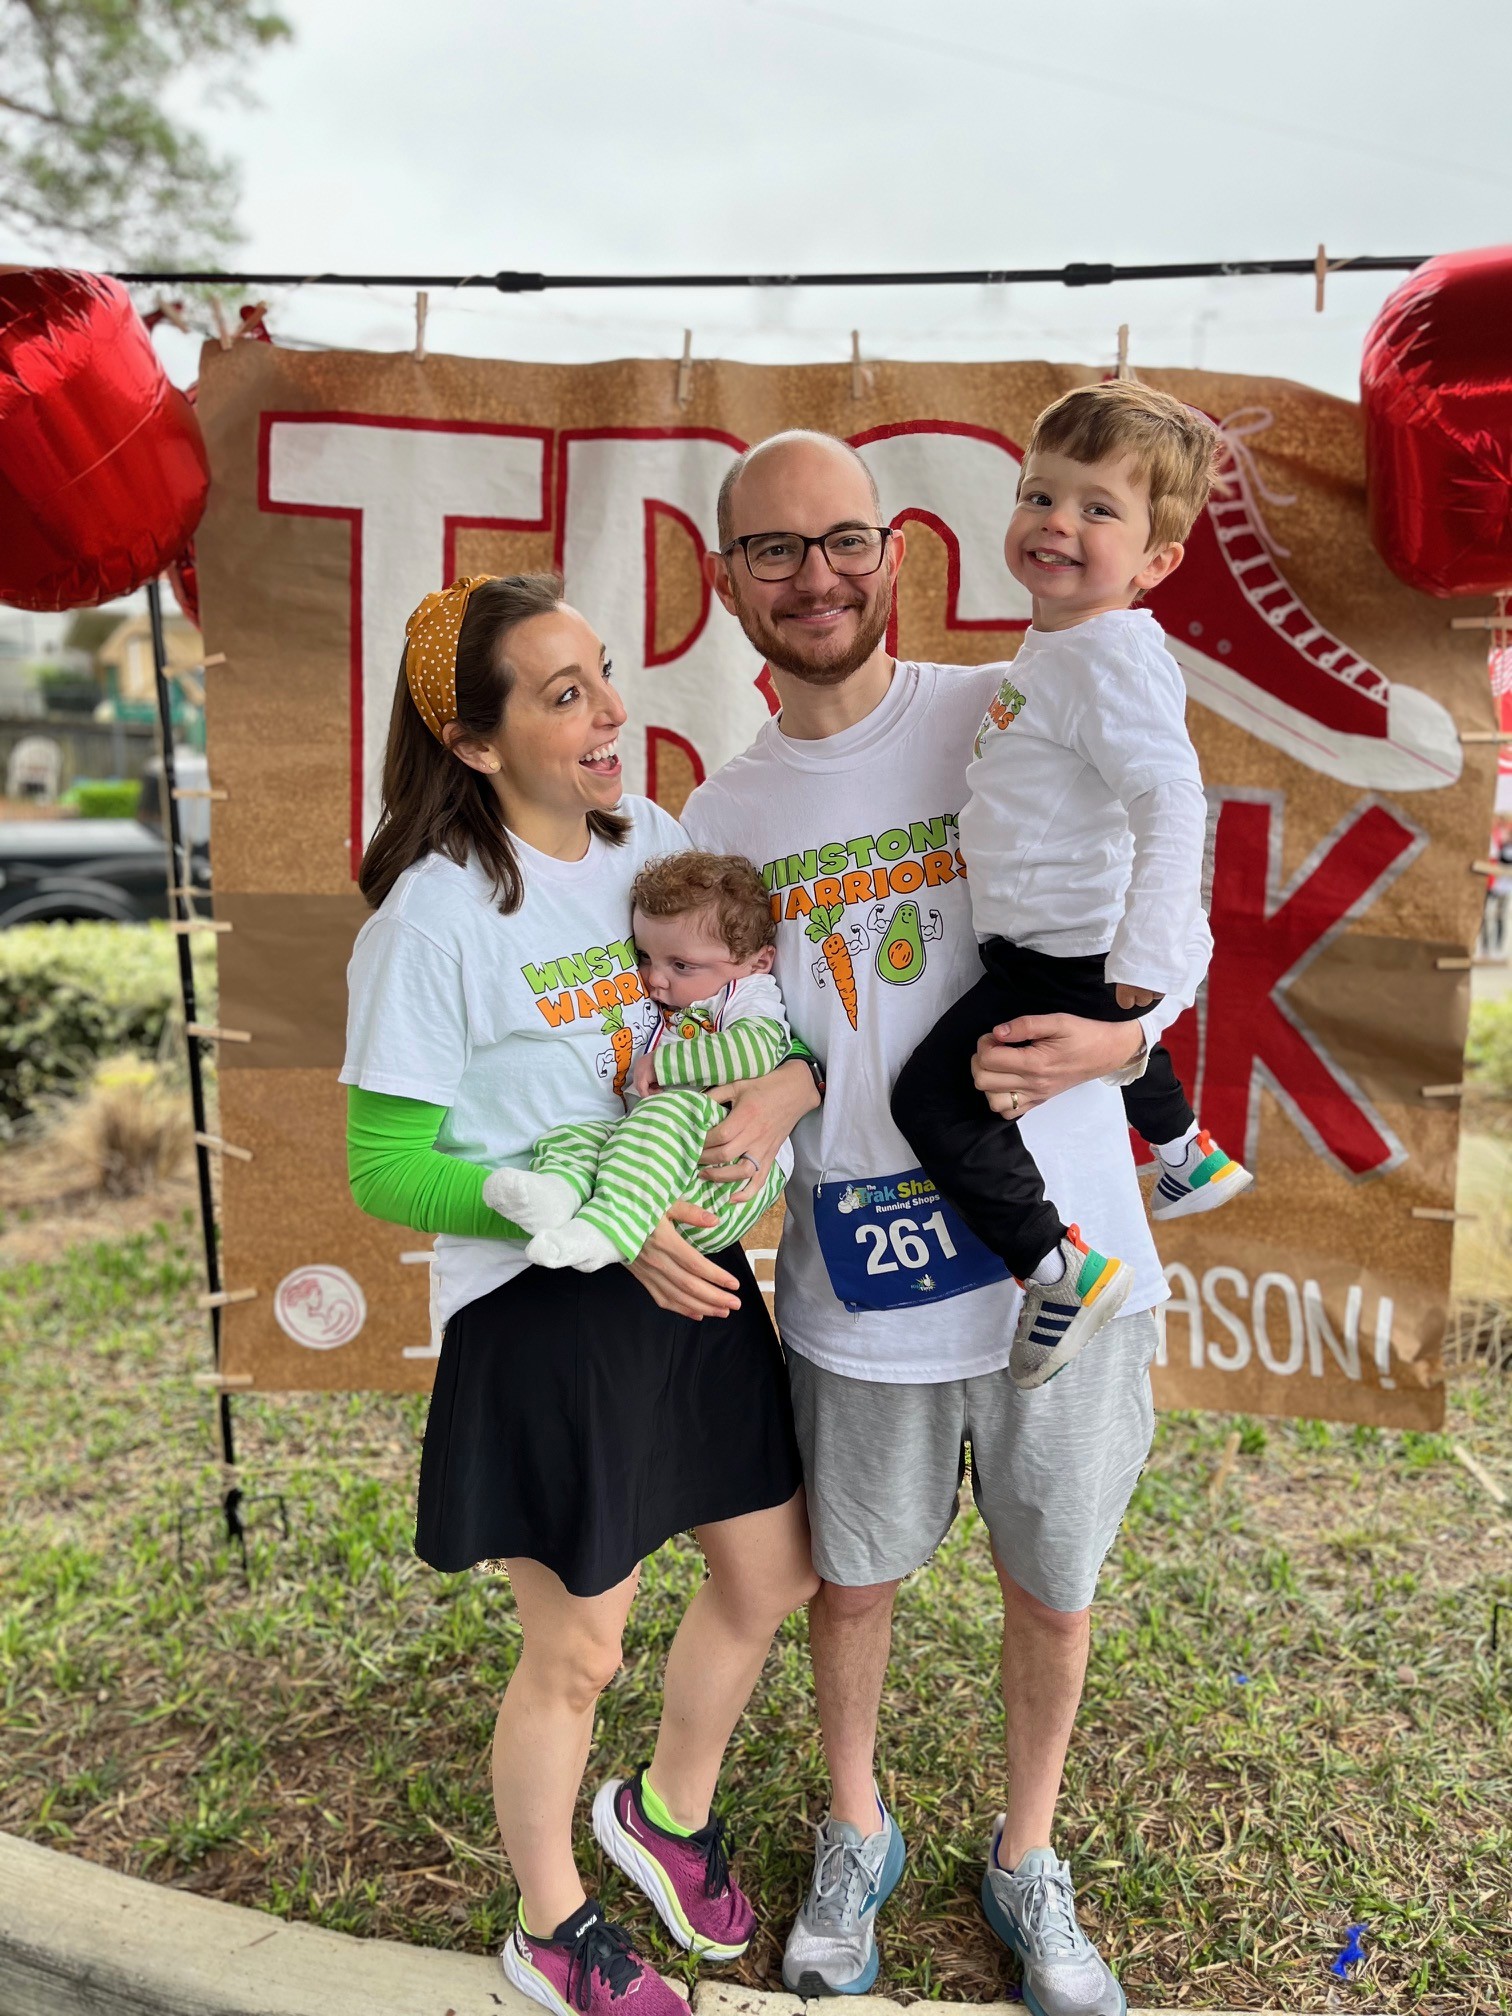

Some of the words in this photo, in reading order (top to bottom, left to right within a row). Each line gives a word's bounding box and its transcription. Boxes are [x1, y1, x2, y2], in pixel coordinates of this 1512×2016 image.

[755, 812, 960, 892] INSTON'
[770, 848, 967, 924] ARRIOR
[520, 936, 638, 995] WNST
[1128, 786, 1431, 1191] K
[859, 1186, 896, 1205] Trak
[875, 1200, 911, 1214] Running
[912, 1193, 941, 1207] Shops
[855, 1210, 958, 1276] 261
